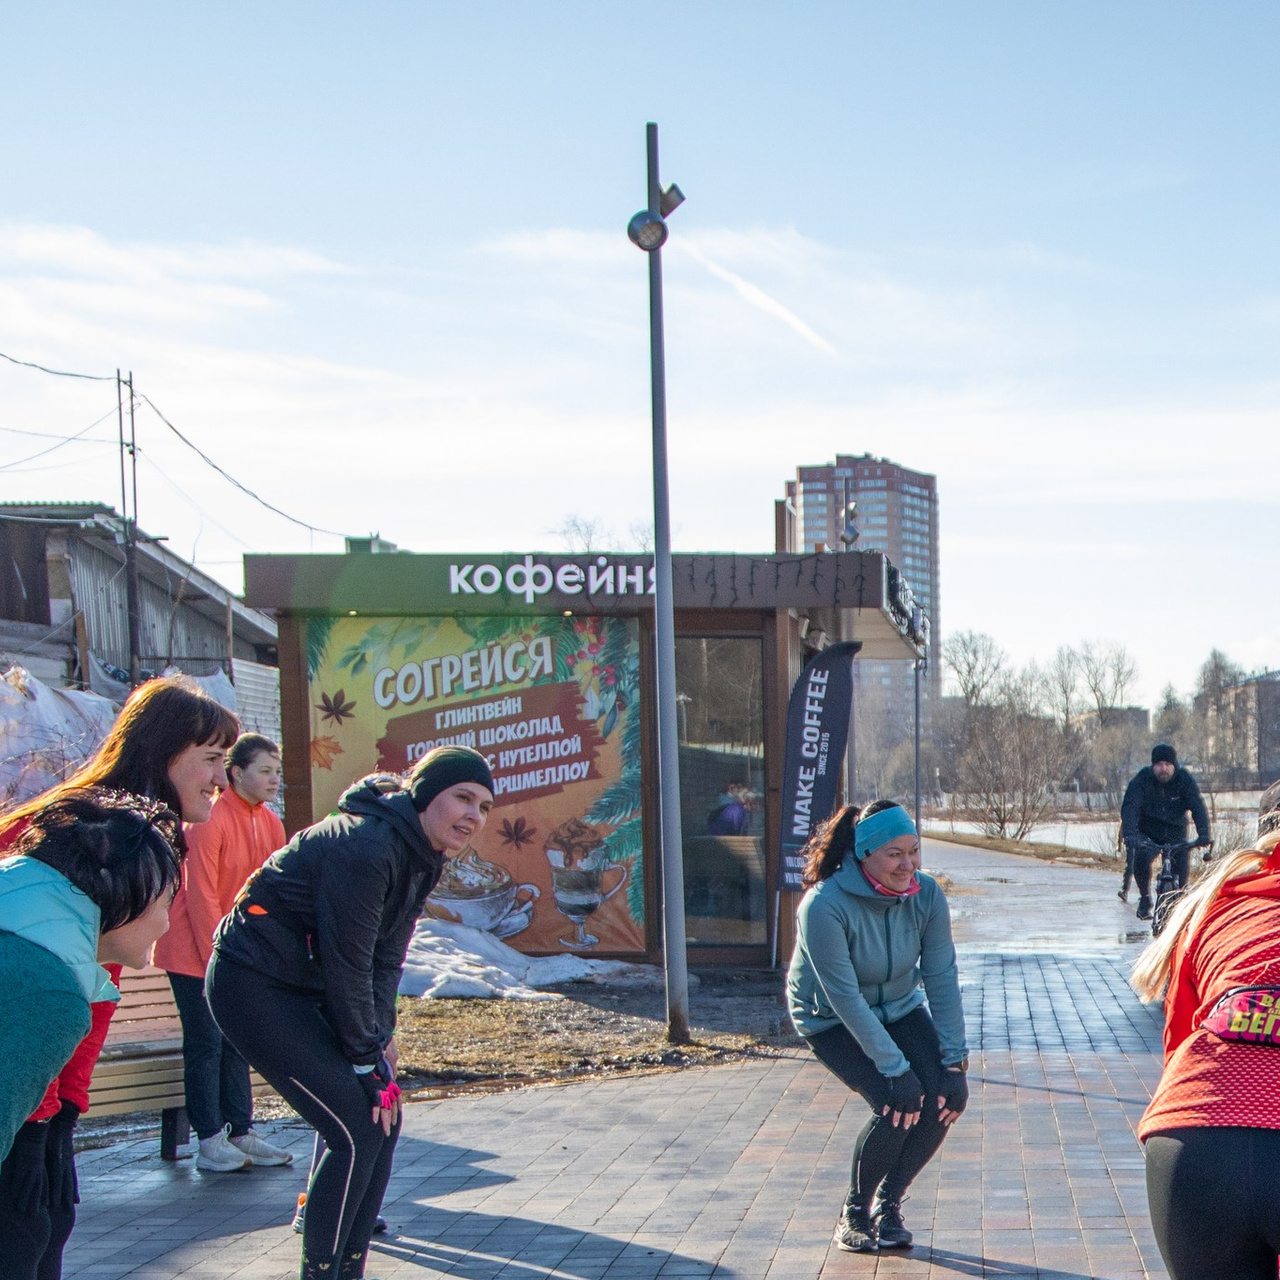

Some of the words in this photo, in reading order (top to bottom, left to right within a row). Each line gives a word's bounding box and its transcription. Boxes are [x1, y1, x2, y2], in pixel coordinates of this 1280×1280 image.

[374, 636, 555, 709] СОГРЕЙСЯ
[435, 696, 522, 730] ГЛИНТВЕЙН
[802, 667, 830, 758] COFFEE
[480, 715, 564, 746] ШОКОЛАД
[820, 732, 831, 752] 2015
[500, 735, 582, 768] НУТЕЛЛОЙ
[818, 753, 828, 775] SINCE
[493, 761, 590, 796] АРШМЕЛЛОУ
[792, 765, 816, 836] MAKE
